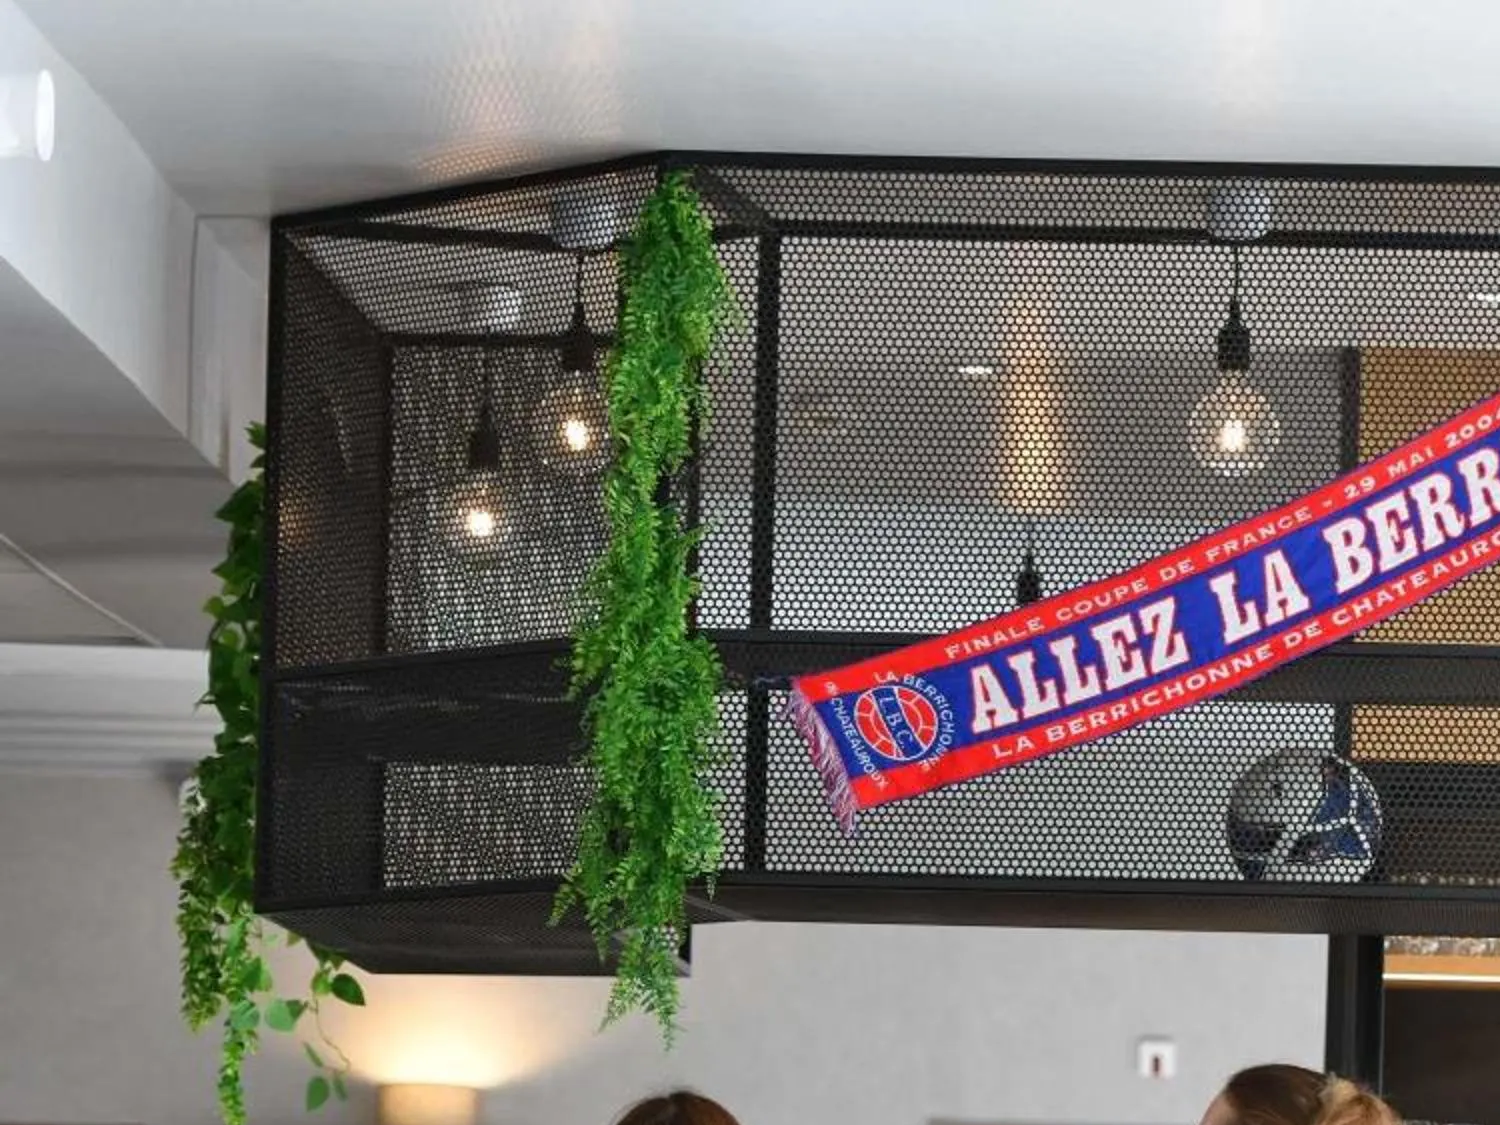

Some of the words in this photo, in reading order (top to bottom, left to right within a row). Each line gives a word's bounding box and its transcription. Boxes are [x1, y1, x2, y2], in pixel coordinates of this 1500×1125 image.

[944, 617, 1045, 660] FINALE
[1056, 578, 1149, 621] COUPE
[1159, 559, 1195, 581] DE
[1205, 506, 1313, 563] FRANCE
[1344, 476, 1376, 499] 29
[1387, 448, 1435, 478] MAI
[873, 671, 899, 683] LA
[970, 596, 1191, 735] ALLEZ
[1208, 549, 1310, 645] LA
[991, 736, 1035, 759] LA
[1046, 643, 1274, 743] BERRICHONNE
[1283, 621, 1325, 649] DE
[831, 697, 889, 791] CHATEAUROUX
